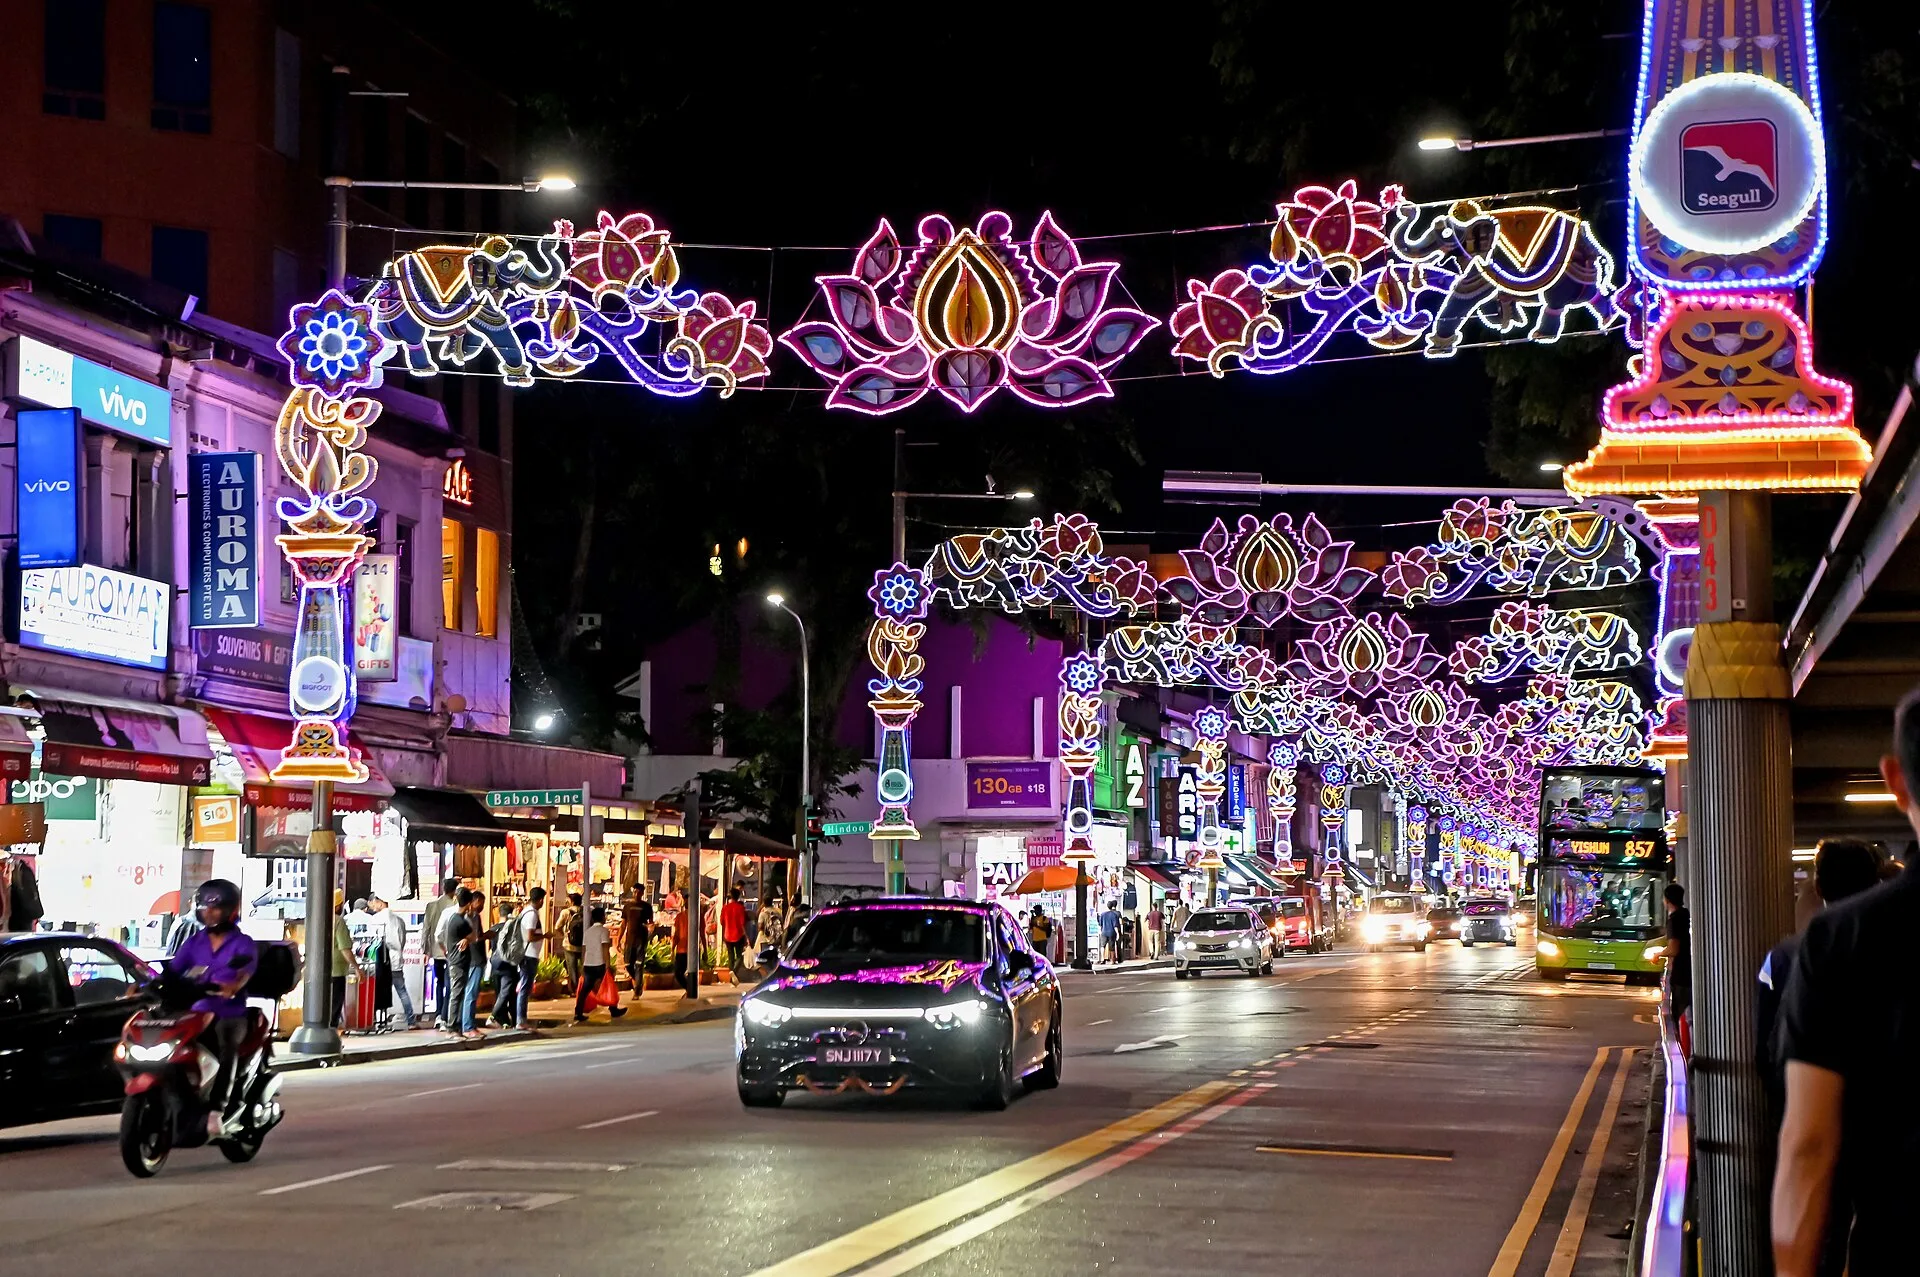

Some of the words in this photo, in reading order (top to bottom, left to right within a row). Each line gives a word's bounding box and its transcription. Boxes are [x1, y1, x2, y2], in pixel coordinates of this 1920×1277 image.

[1698, 189, 1761, 208] Seagull
[99, 385, 147, 426] vivo
[24, 478, 71, 493] vivo
[202, 463, 211, 521] ELECTRONICS
[202, 522, 211, 530] &
[217, 461, 249, 618] AUROMA
[203, 530, 212, 584] COMPUTERS
[361, 563, 389, 576] 214
[48, 570, 150, 622] AUROMA
[203, 585, 212, 602] PTE
[203, 603, 212, 620] LTD
[217, 634, 261, 661] SOUVENIRS
[357, 659, 390, 669] GIFTS
[1027, 783, 1045, 793] $18
[1232, 775, 1240, 815] MEDSTAR
[493, 793, 539, 805] Baboo
[545, 792, 579, 804] Lane
[828, 824, 864, 834] Hindoo
[1029, 845, 1061, 855] MOBILE
[1571, 840, 1610, 854] YISHUN
[1624, 840, 1655, 858] 857
[1030, 857, 1060, 867] REPAIR
[826, 1049, 882, 1063] SNJ1117Y
